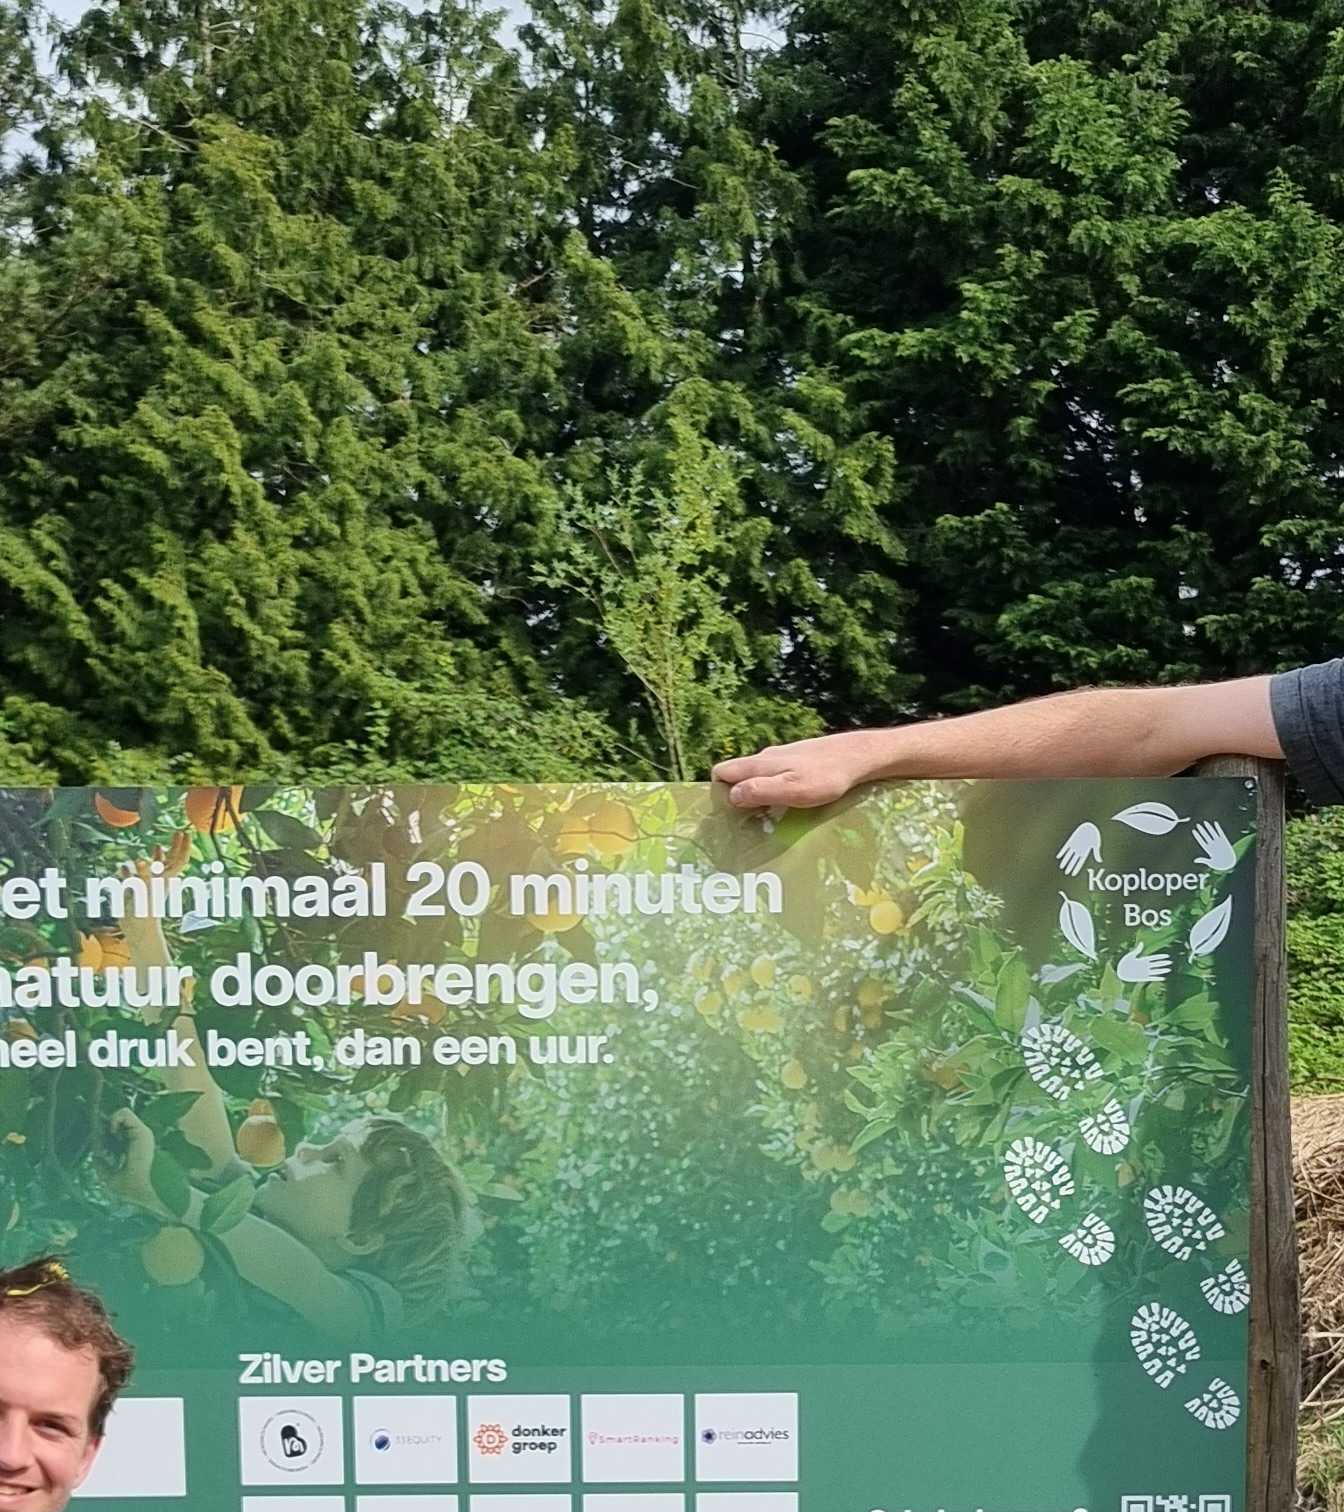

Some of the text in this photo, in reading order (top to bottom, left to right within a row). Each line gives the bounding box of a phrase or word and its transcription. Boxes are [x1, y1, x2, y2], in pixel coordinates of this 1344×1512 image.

[86, 860, 387, 919] minimaal
[406, 861, 491, 917] 20
[511, 857, 783, 917] minuten
[1087, 868, 1211, 897] Koploper
[1123, 903, 1173, 928] Bos
[211, 950, 658, 1020] doorbrengen,
[89, 1029, 196, 1068] druk
[208, 1029, 323, 1072] bent,
[336, 1029, 421, 1065] dan
[433, 1033, 516, 1066] een
[529, 1033, 615, 1065] uur.
[238, 1352, 508, 1384] Zilver Partners
[511, 1424, 566, 1438] donker
[511, 1440, 558, 1455] groep
